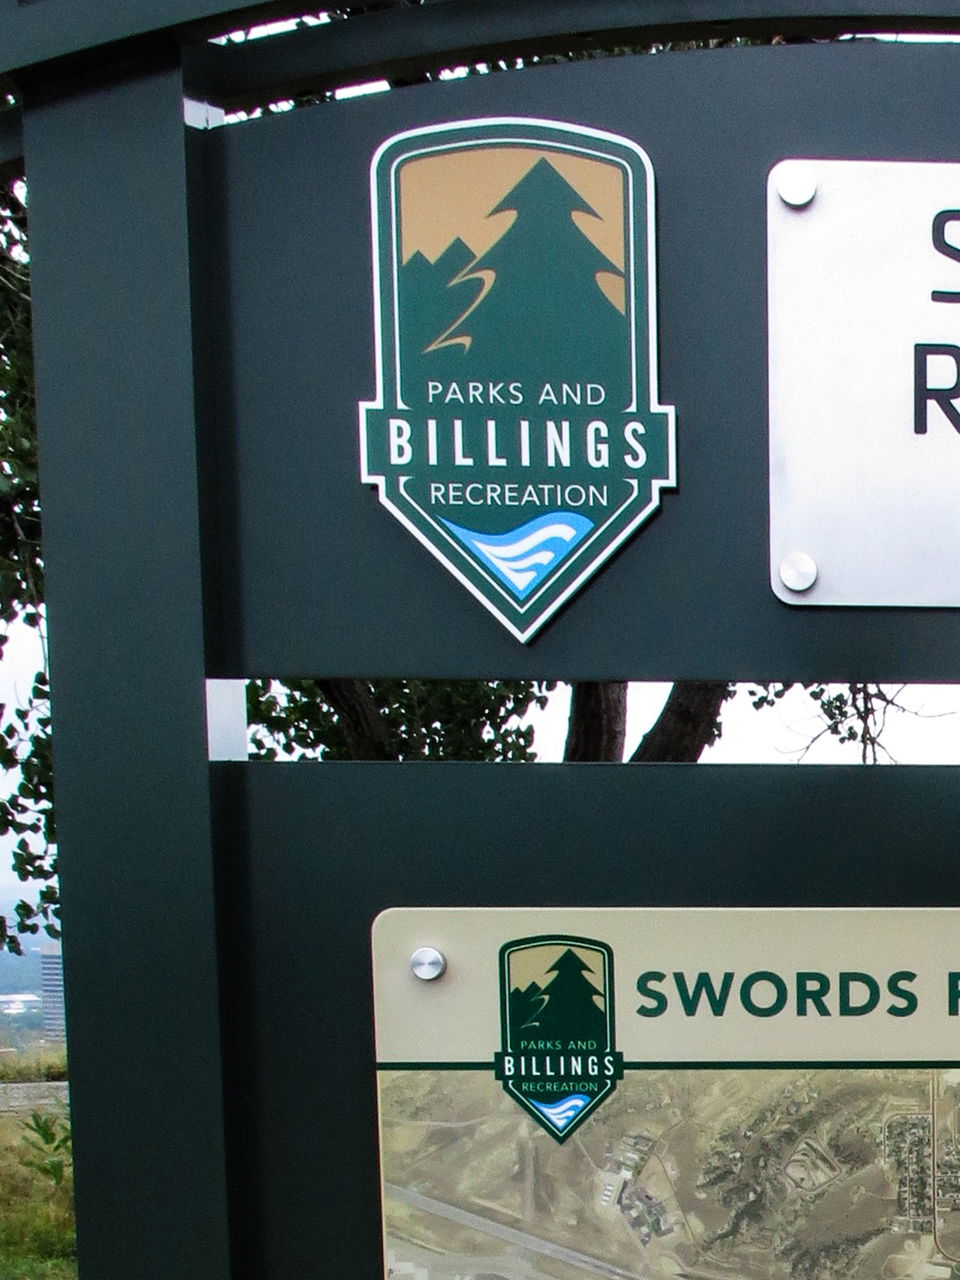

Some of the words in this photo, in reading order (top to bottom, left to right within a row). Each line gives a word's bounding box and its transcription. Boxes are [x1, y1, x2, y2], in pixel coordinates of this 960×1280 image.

[428, 382, 523, 405] PARKS
[539, 383, 606, 405] AND
[389, 419, 647, 468] BILLINGS
[430, 484, 608, 506] RECREATION
[635, 971, 919, 1018] SWORDS
[521, 1040, 562, 1050] PARKS
[568, 1040, 596, 1050] AND
[505, 1056, 614, 1076] BILLINGS
[522, 1082, 598, 1091] RECREATION
